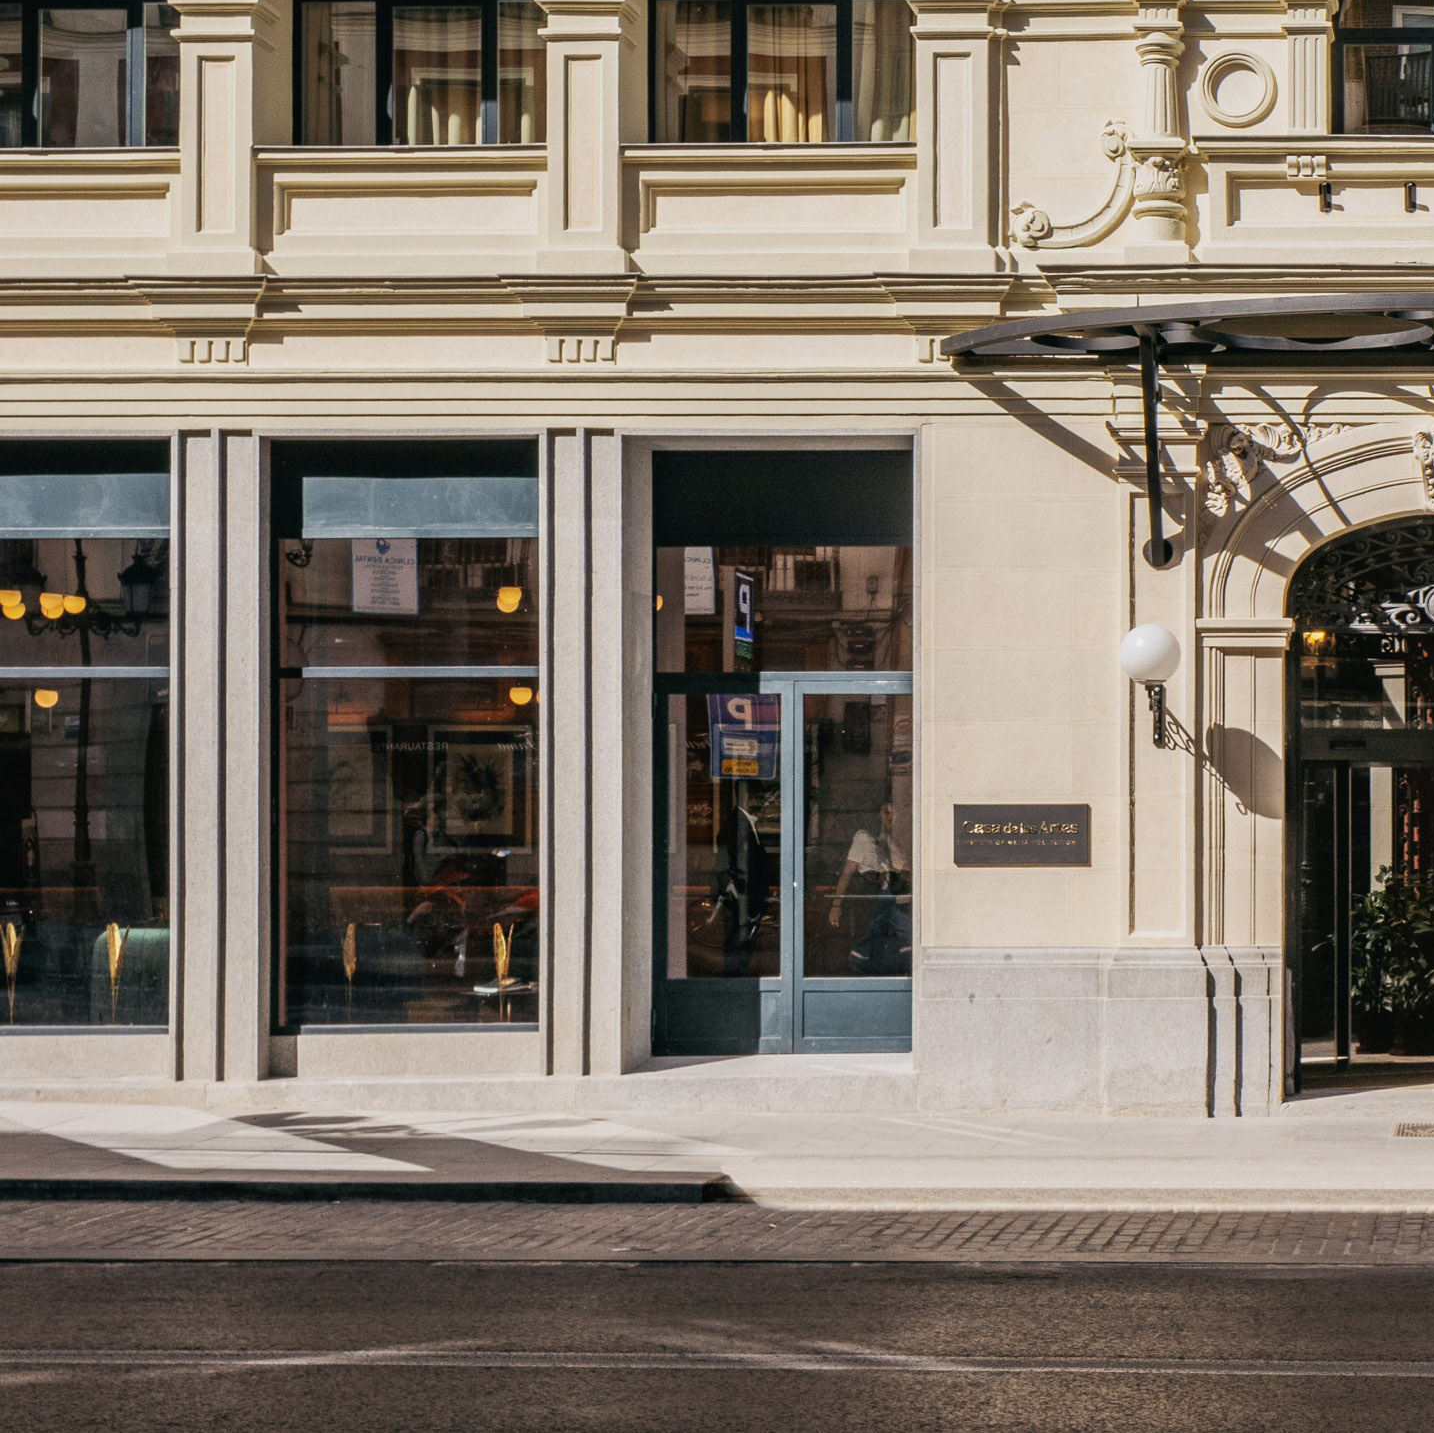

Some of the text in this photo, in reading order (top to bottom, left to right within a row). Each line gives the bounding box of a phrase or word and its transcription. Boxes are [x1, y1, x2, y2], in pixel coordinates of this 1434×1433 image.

[962, 820, 1079, 834] Casa de las Artes
